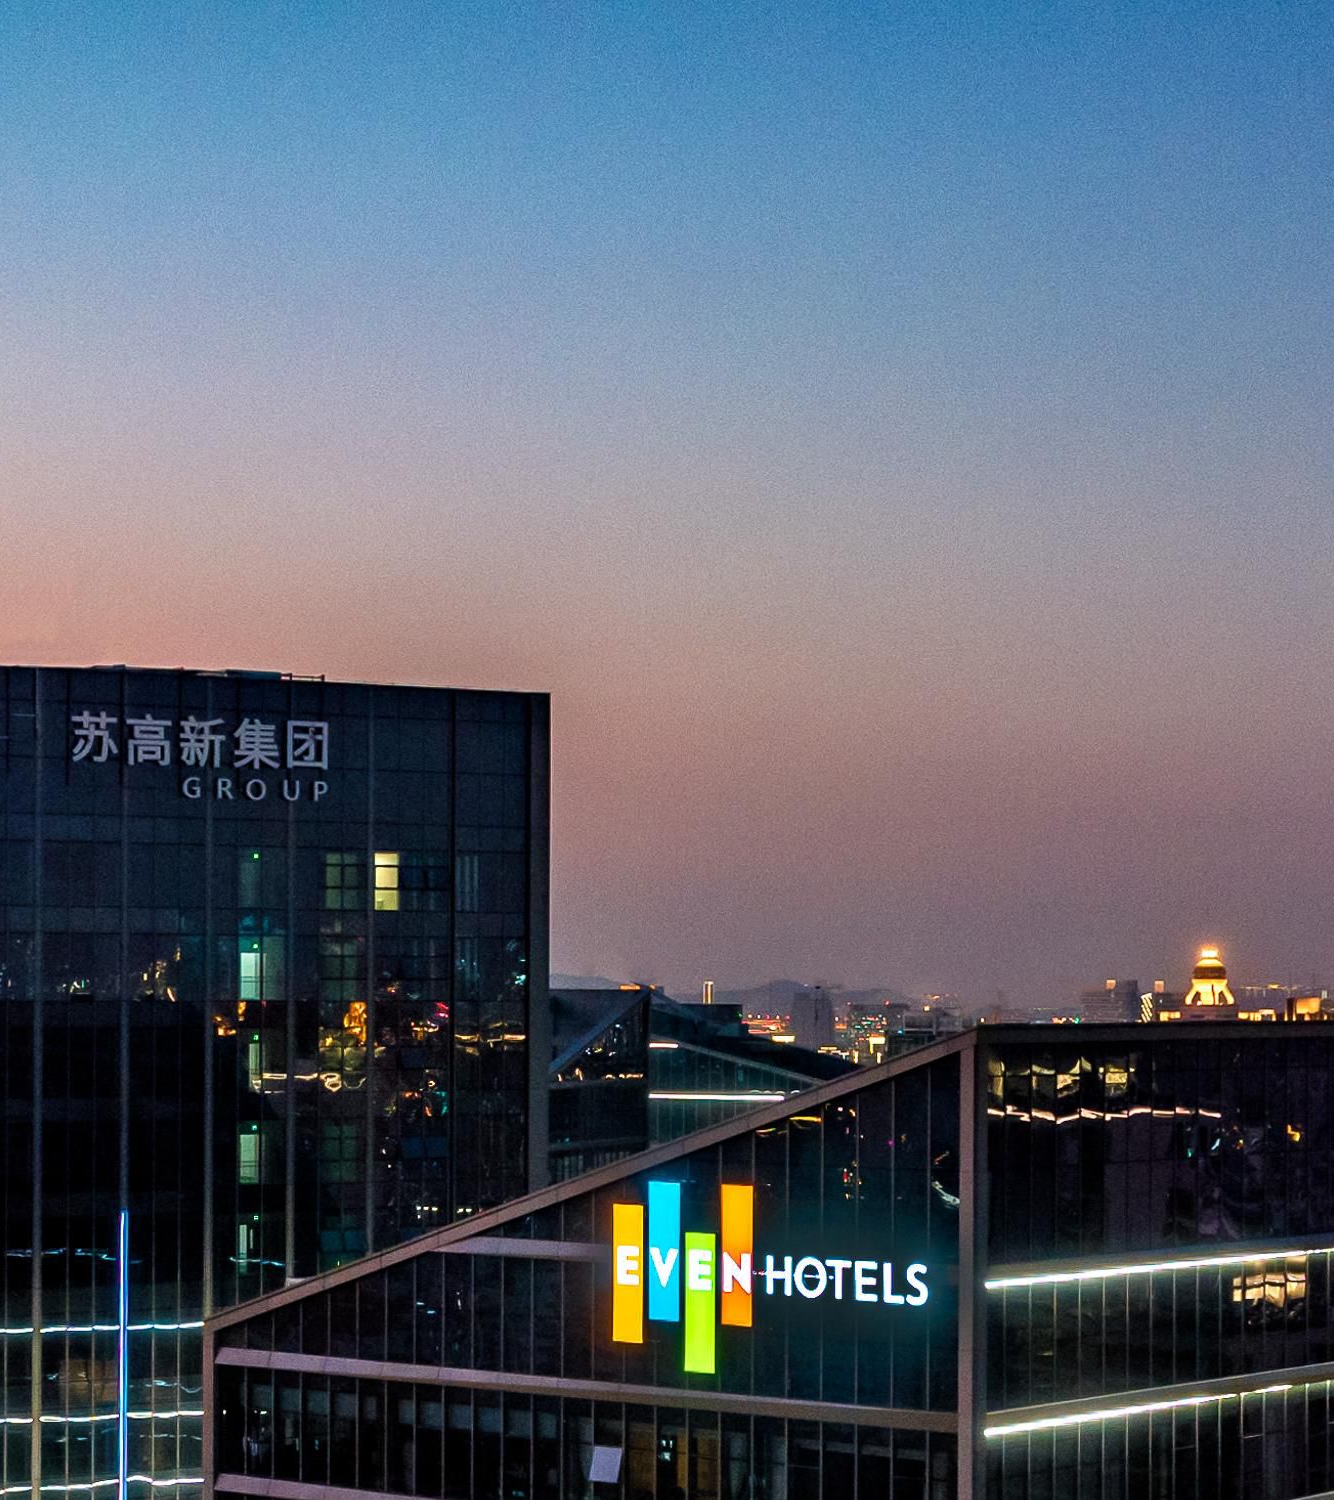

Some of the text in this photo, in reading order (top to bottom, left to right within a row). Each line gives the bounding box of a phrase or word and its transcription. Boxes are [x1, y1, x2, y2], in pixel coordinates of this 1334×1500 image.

[70, 709, 329, 770] 苏高新集团
[182, 776, 329, 801] GROUP
[616, 1244, 929, 1306] EVEN HOTELS
